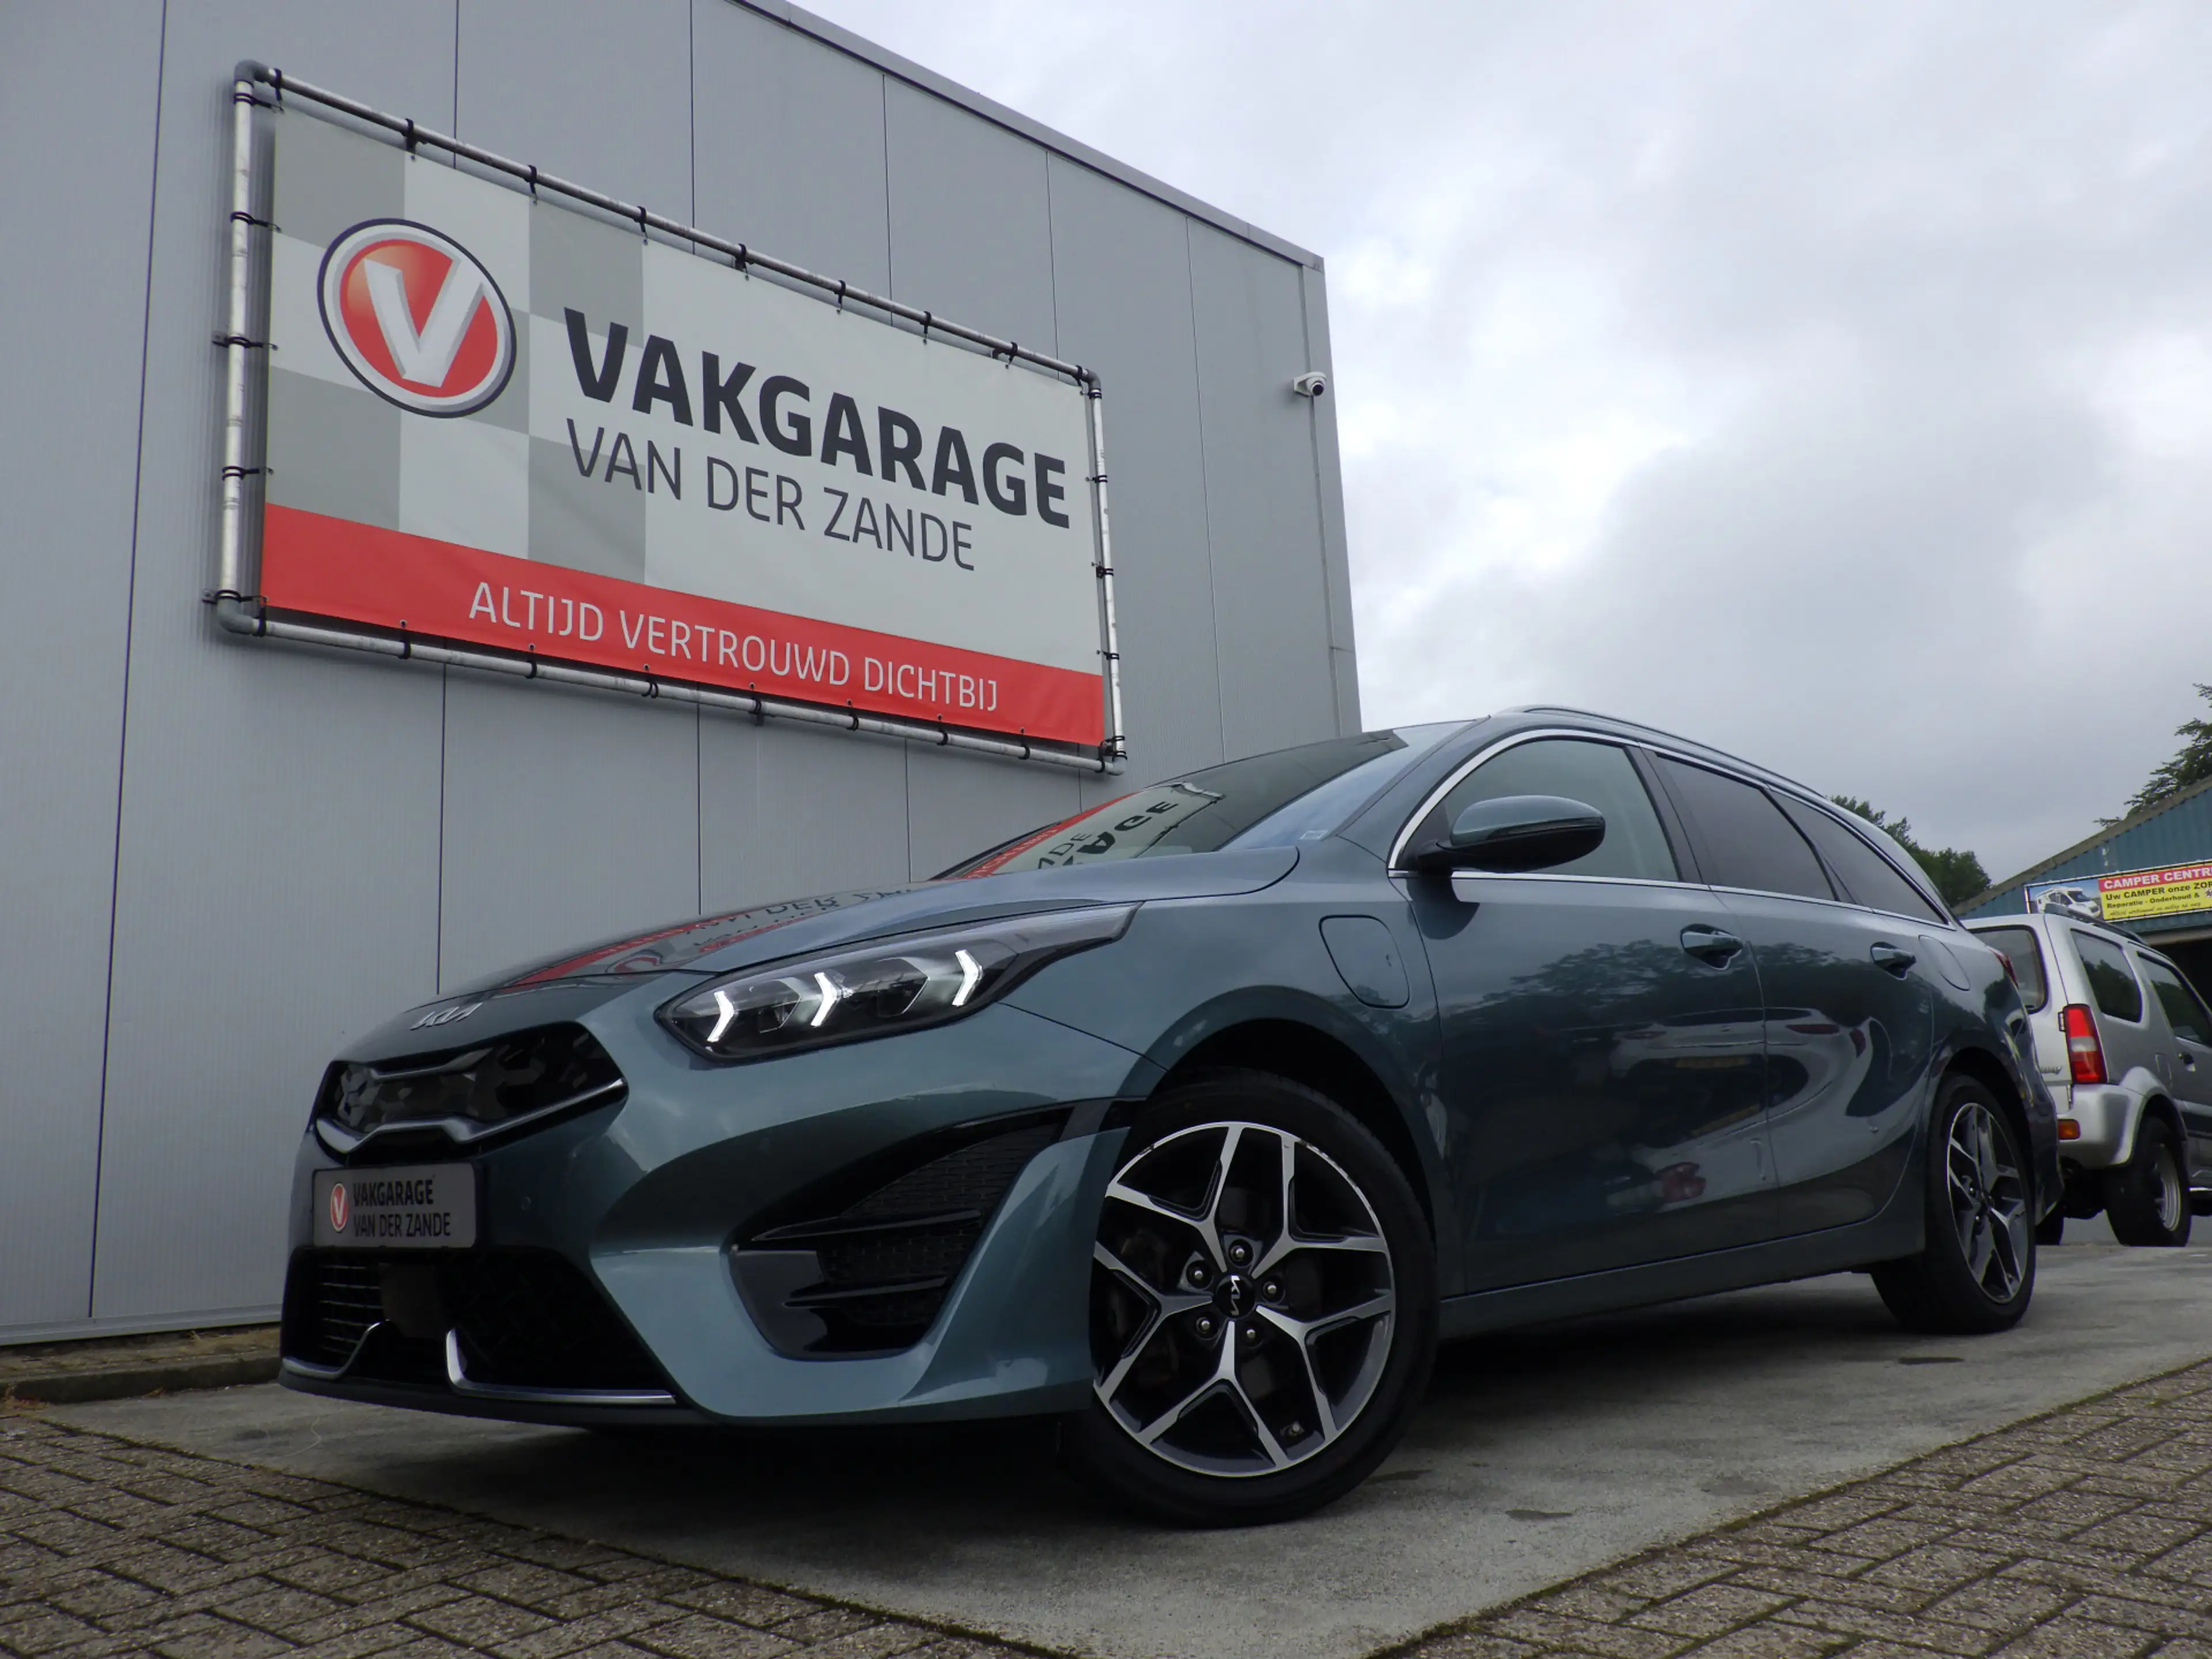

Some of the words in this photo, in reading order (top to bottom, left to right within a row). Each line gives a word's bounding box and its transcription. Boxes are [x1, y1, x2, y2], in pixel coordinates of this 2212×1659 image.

[564, 307, 1070, 528] VAKGARAGE
[566, 418, 682, 501] VAN
[707, 456, 805, 531] DER
[823, 487, 975, 571] ZANDE
[469, 582, 604, 641] ALTIJD
[620, 610, 850, 685] VERTROUWD
[863, 657, 998, 712] DICHTBIJ
[2104, 874, 2160, 889] CAMPER
[2164, 867, 2212, 881] CENTR
[2124, 887, 2165, 898] CAMPER
[2150, 894, 2191, 903] Onderhoud
[353, 1179, 434, 1207] VAKGARAGE
[354, 1214, 376, 1237] VAN
[380, 1214, 402, 1237] DER
[406, 1212, 451, 1237] ZANDE
